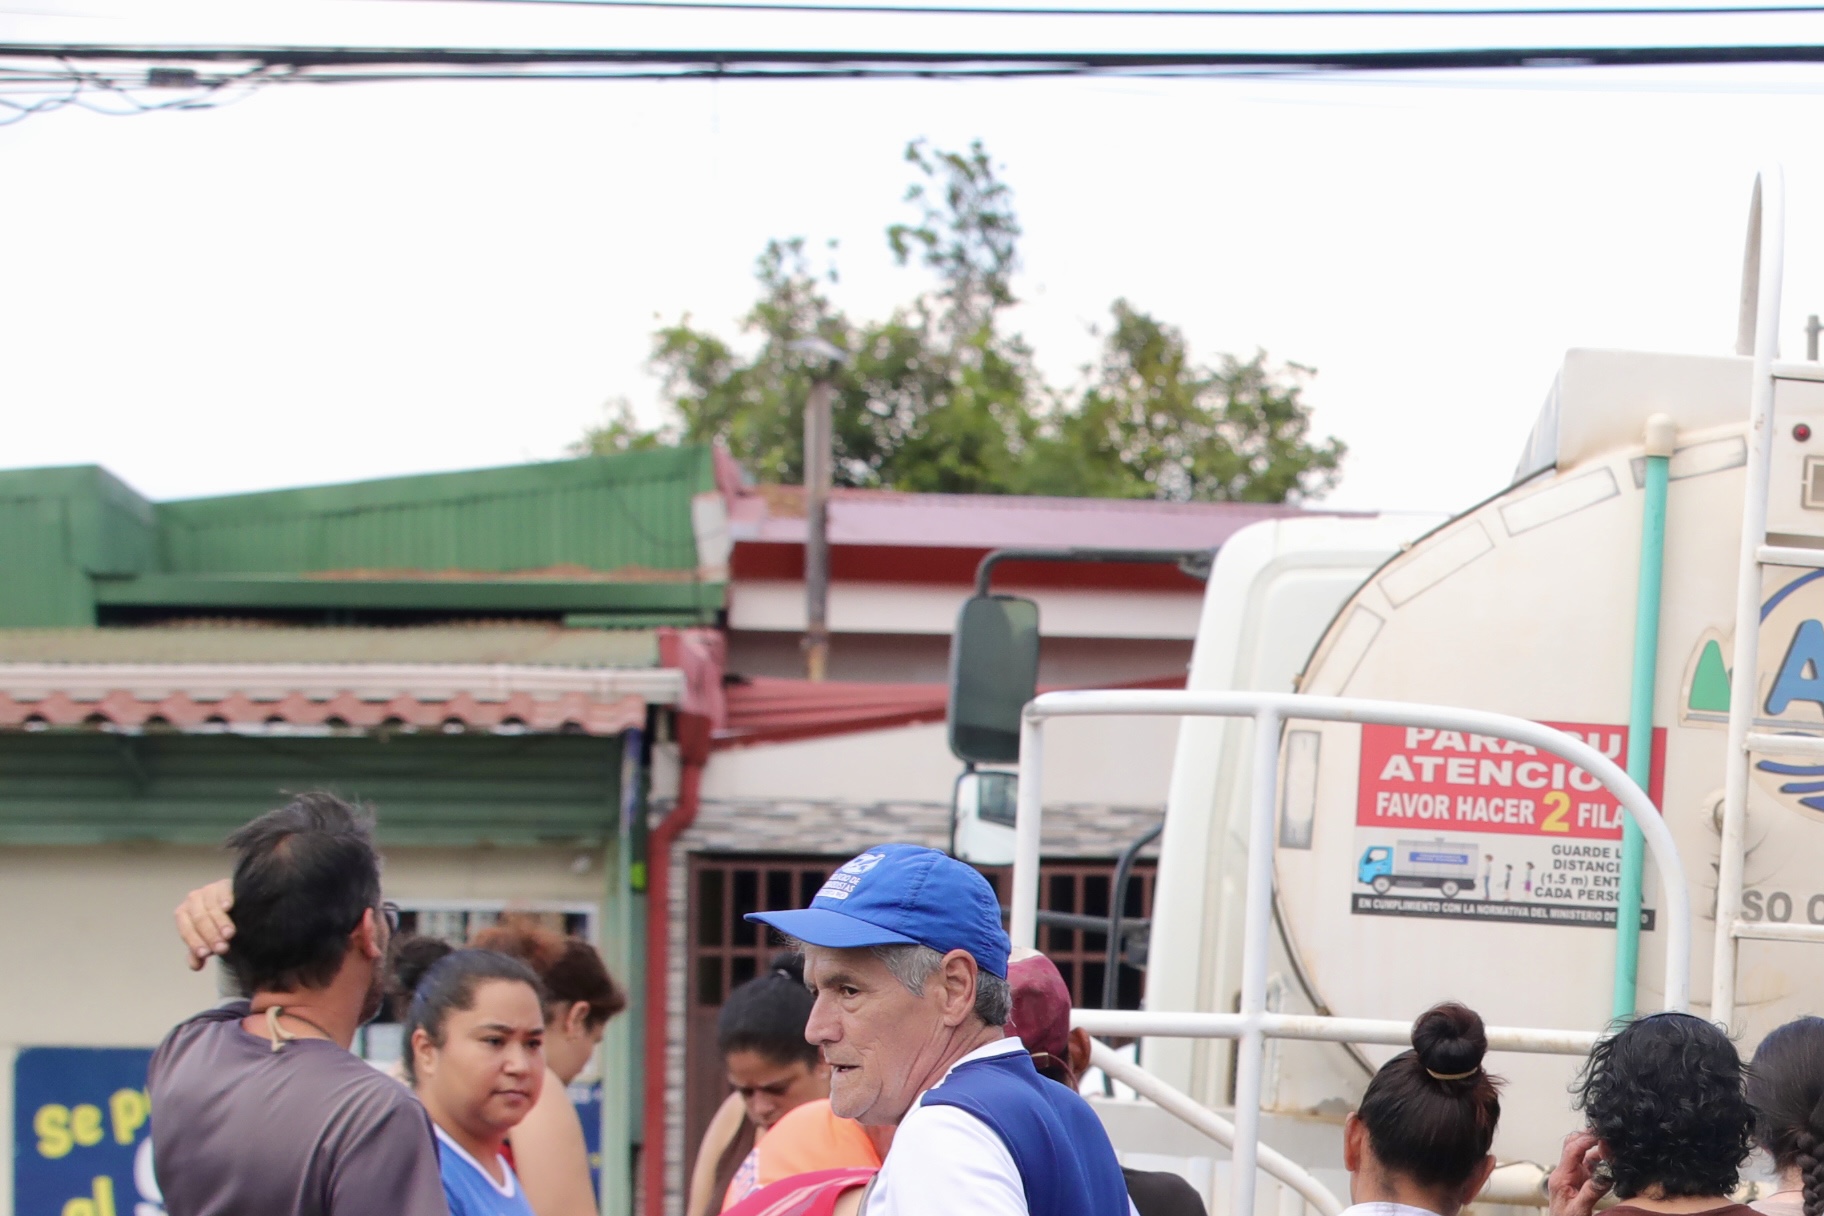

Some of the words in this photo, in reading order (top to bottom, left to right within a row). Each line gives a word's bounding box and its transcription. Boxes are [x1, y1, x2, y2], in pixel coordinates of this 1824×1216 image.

[1405, 727, 1538, 755] PARA
[1562, 731, 1622, 760] U
[1376, 791, 1450, 820] FAVOR
[1456, 796, 1536, 825] HACER
[1540, 791, 1571, 833] 2
[1577, 802, 1625, 830] FILA
[1551, 845, 1611, 859] GUARDE
[1553, 859, 1622, 873] DISTANCI
[1540, 872, 1567, 886] (1.5
[1571, 875, 1589, 888] m)
[1593, 876, 1622, 888] ENT
[1534, 887, 1573, 900] CADA
[1358, 898, 1372, 909] EN
[1372, 899, 1441, 912] CUMPLIMIENTO
[1441, 902, 1462, 914] CON
[1463, 903, 1476, 914] LA
[1476, 904, 1530, 918] NORMATIVA
[1530, 907, 1549, 919] DEL
[1549, 908, 1603, 922] MINISTERIO
[1740, 889, 1793, 924] SO
[109, 1087, 152, 1146] P
